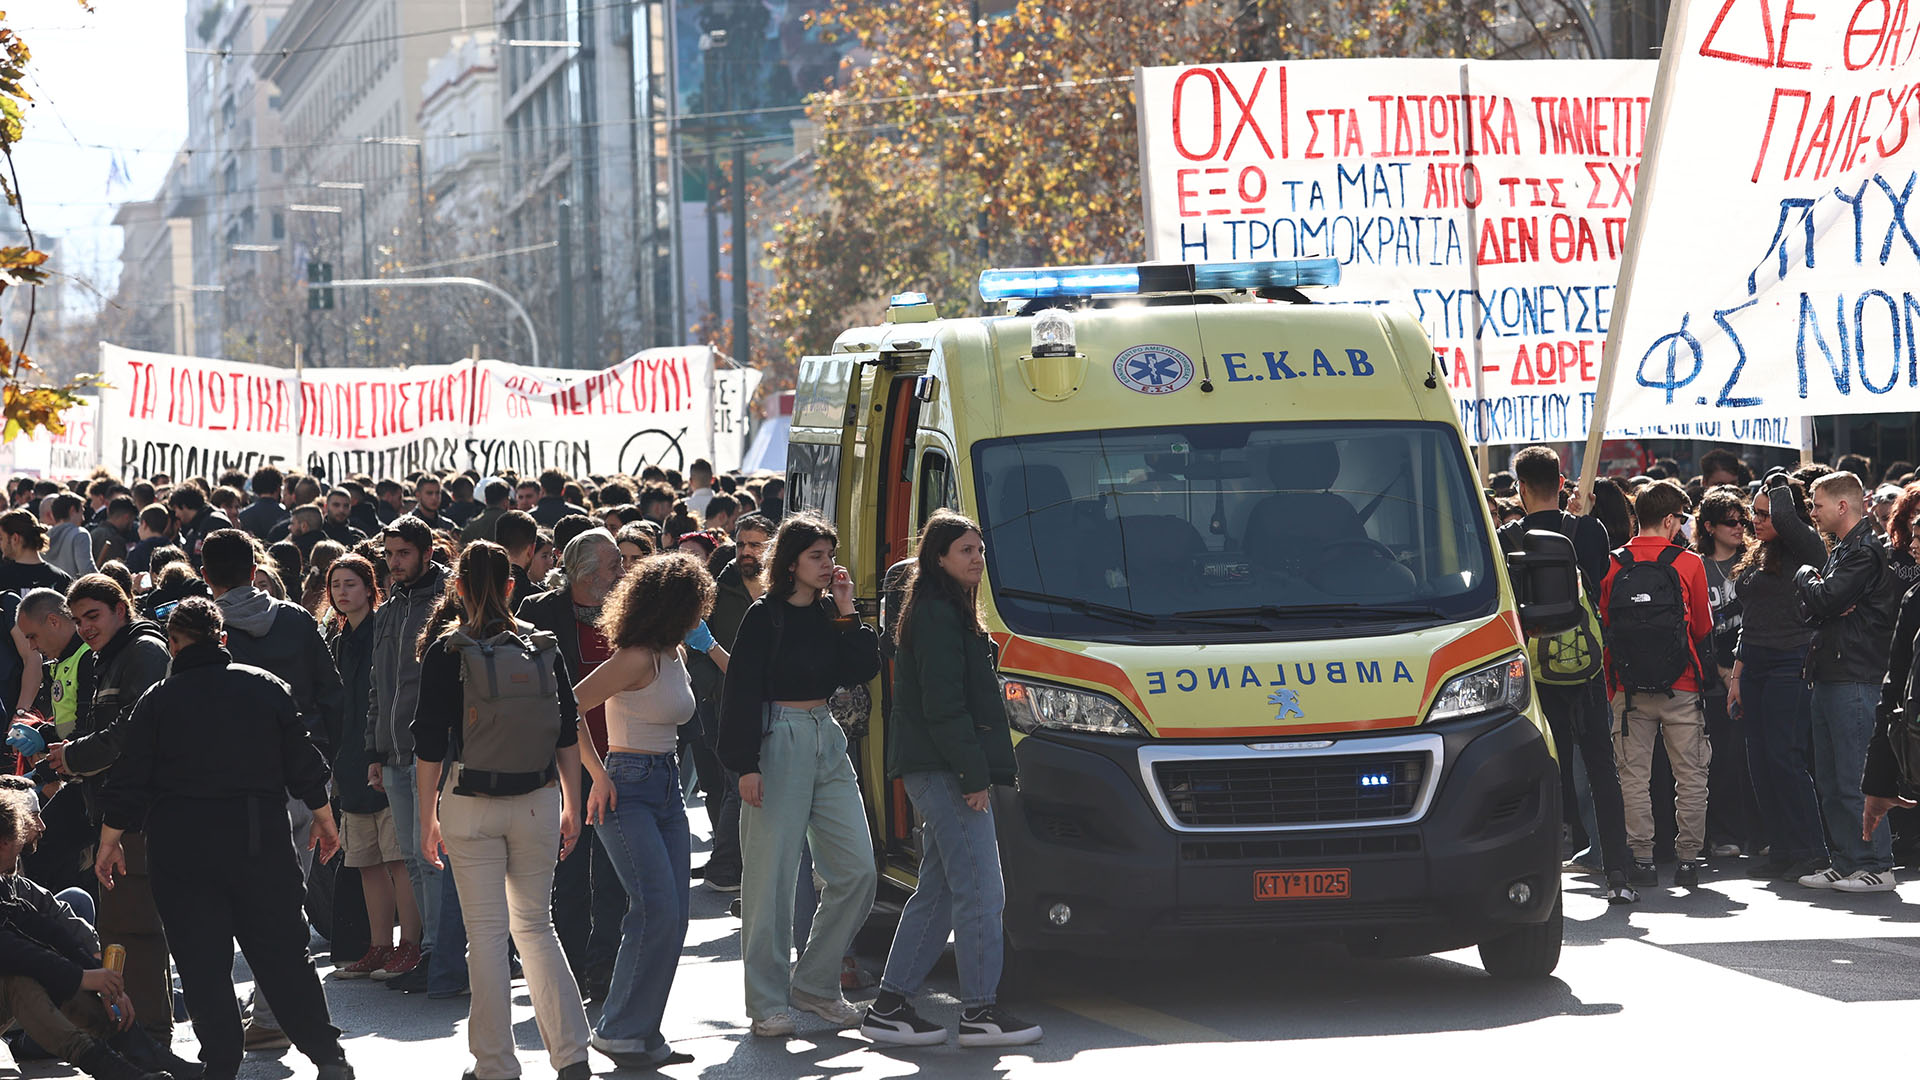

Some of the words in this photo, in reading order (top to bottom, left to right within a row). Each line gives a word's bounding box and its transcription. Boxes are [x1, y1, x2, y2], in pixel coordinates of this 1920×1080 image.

[1172, 66, 1289, 161] ΟΧΙ
[1305, 108, 1364, 159] ΣΤΑ
[1368, 95, 1521, 157] ΙΔΙΩΤΙΚΑ
[1177, 165, 1267, 217] ΕΞΩ
[1282, 180, 1325, 212] ΤΑ
[1337, 162, 1411, 209] ΜΑΤ
[1423, 162, 1483, 209] ΑΠΟ
[1499, 177, 1567, 208] ΤΙΣ
[1585, 161, 1641, 209] ΣΧ
[1181, 222, 1208, 262] Η
[1223, 215, 1462, 266] ΤΡΟΜΟΚΡΑΤΙΑ
[1477, 215, 1538, 265] ΔΕΝ
[1549, 212, 1598, 262] ΘΑ
[1511, 340, 1609, 386] ΔΩΡΕ
[128, 361, 157, 418] ΤΑ
[168, 367, 291, 433] ΙΔΙΩΤΙΚΑ
[301, 366, 491, 440] ΠΑΝΕΠΙΣΤΗΜΙΑ
